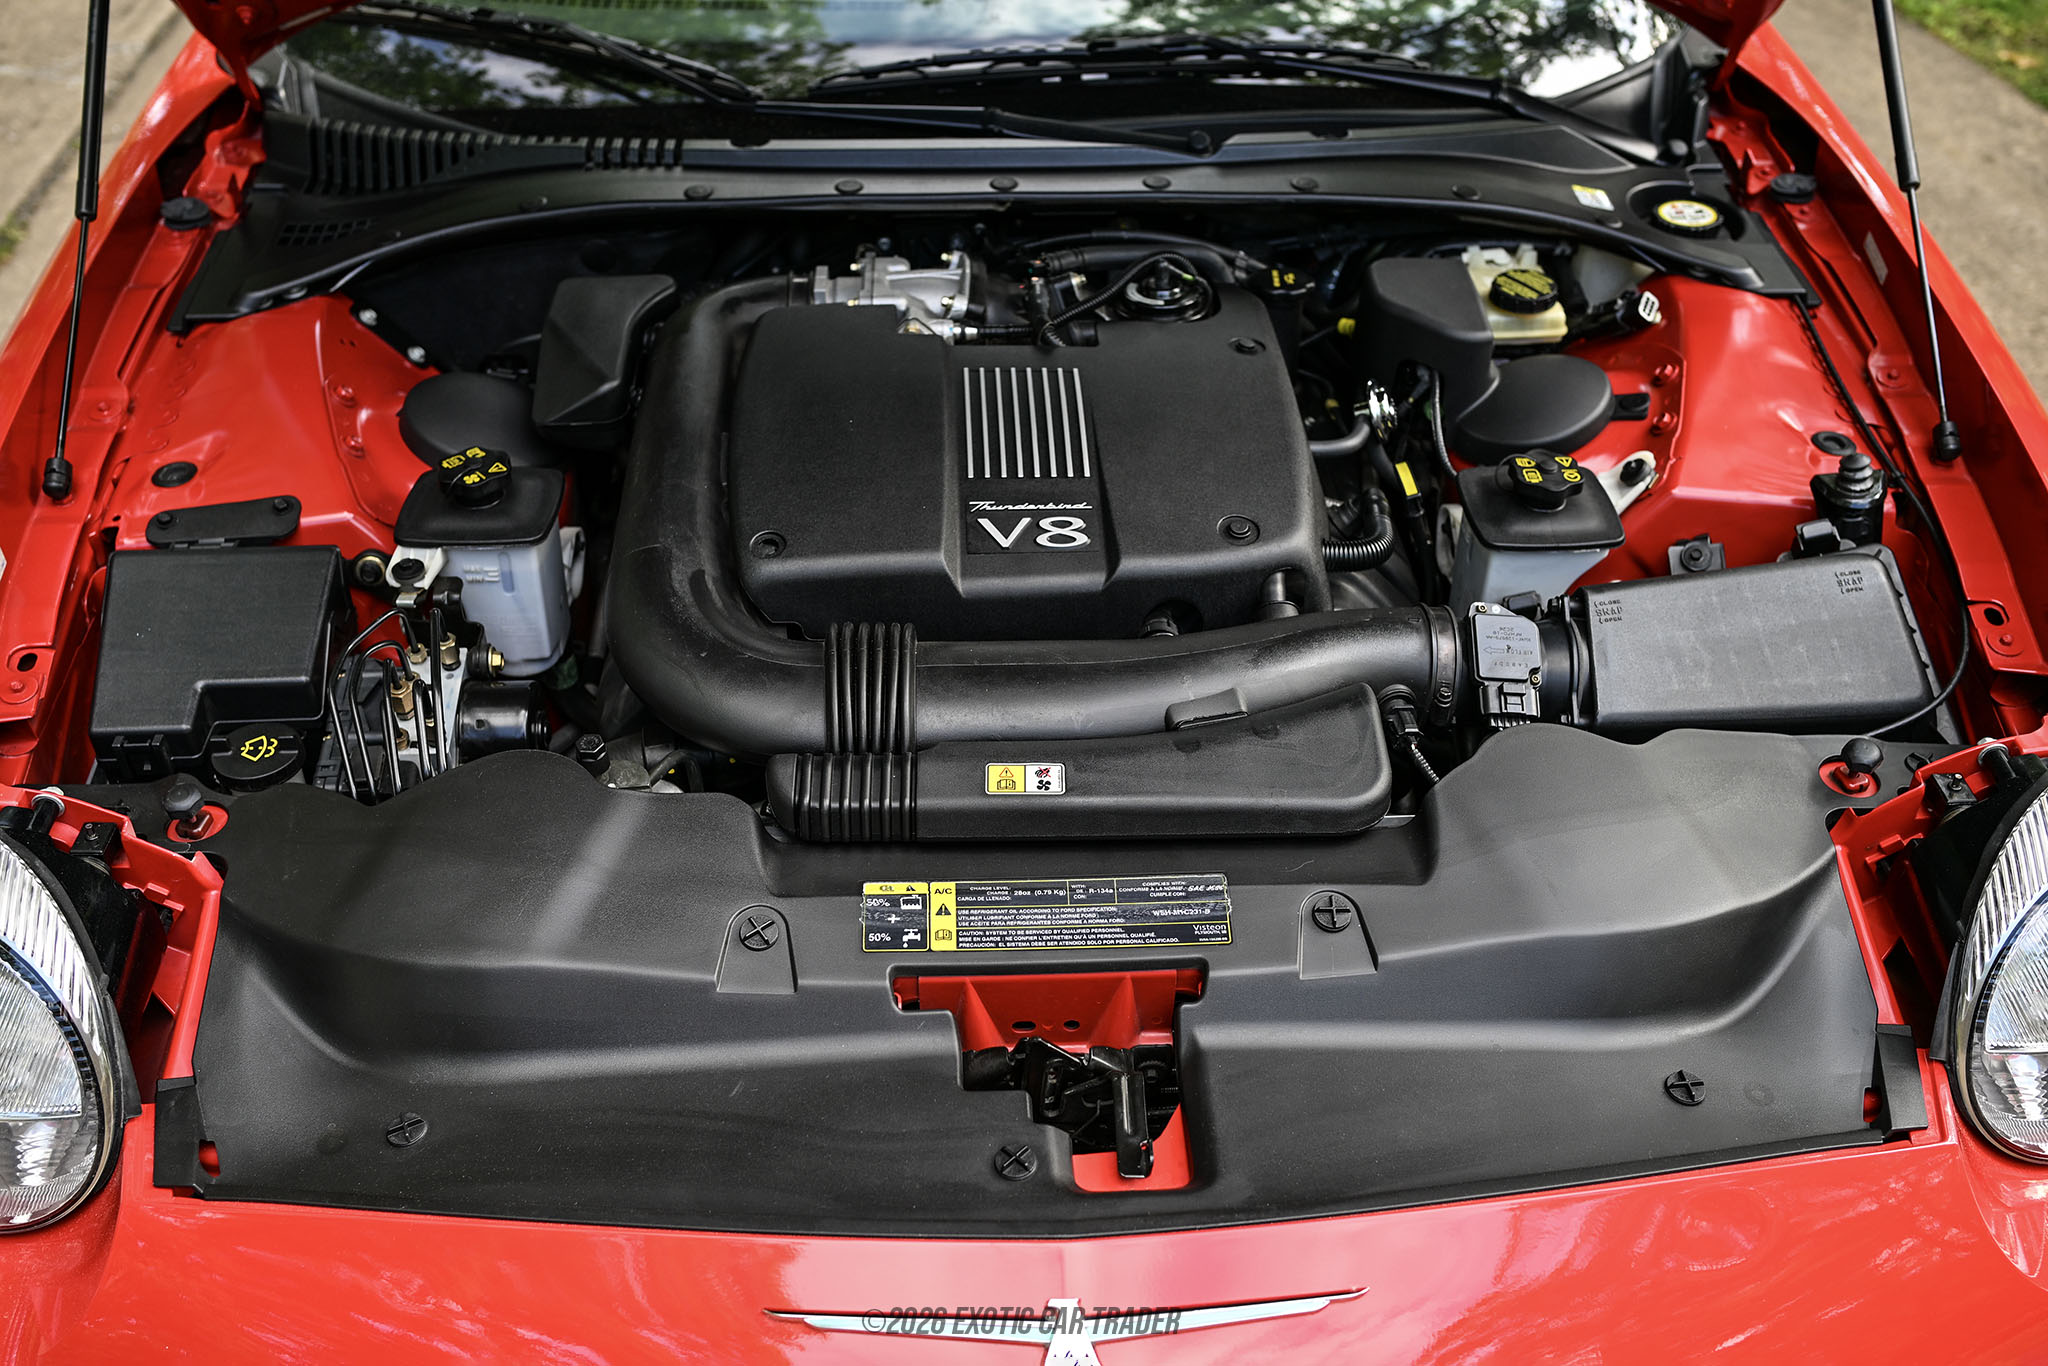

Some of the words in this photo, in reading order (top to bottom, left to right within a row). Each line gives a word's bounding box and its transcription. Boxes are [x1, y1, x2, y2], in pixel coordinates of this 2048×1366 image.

[969, 501, 1093, 513] Thunderbird
[977, 516, 1091, 549] V8
[868, 932, 892, 942] 50%
